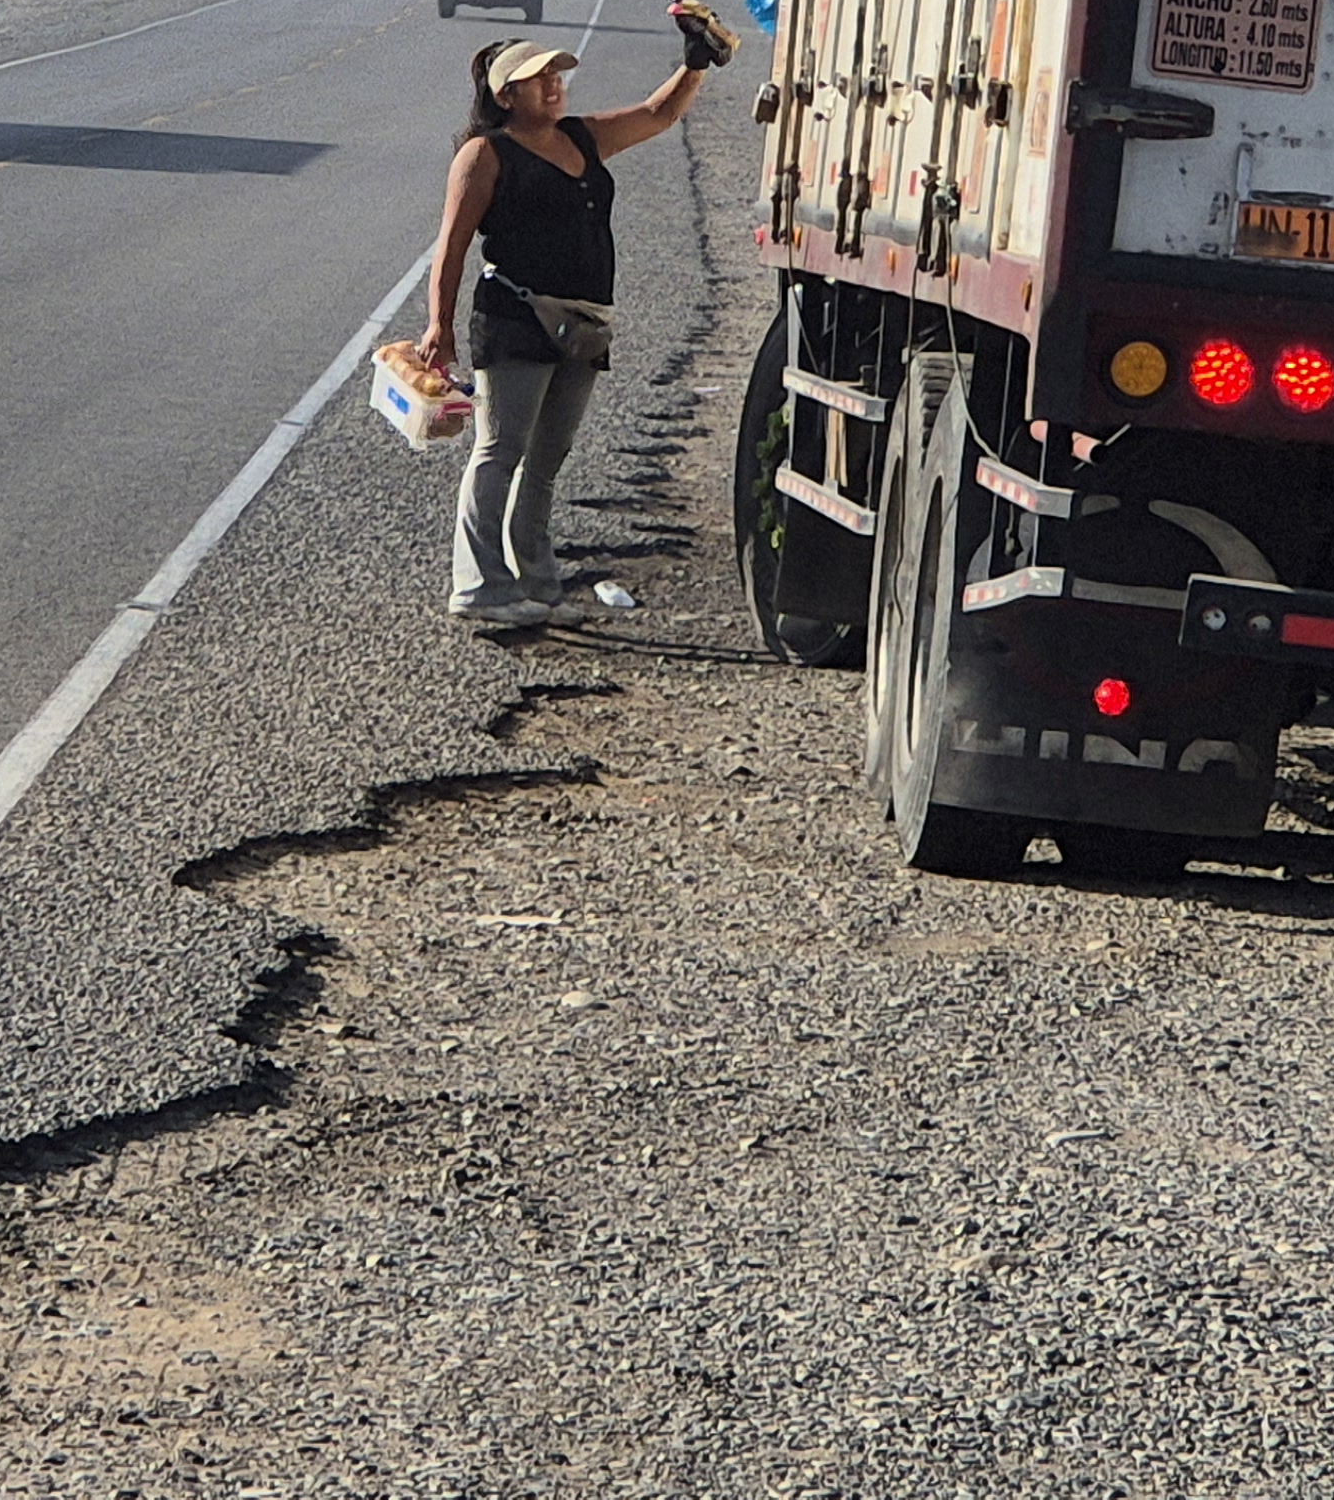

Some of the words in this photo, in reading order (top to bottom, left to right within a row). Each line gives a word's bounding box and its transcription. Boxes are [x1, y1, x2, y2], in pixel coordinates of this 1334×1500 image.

[1281, 4, 1309, 22] mts
[1247, 21, 1276, 48] 4.10
[1278, 29, 1305, 49] mts
[1238, 50, 1273, 77] 11.50
[1275, 60, 1303, 78] mts
